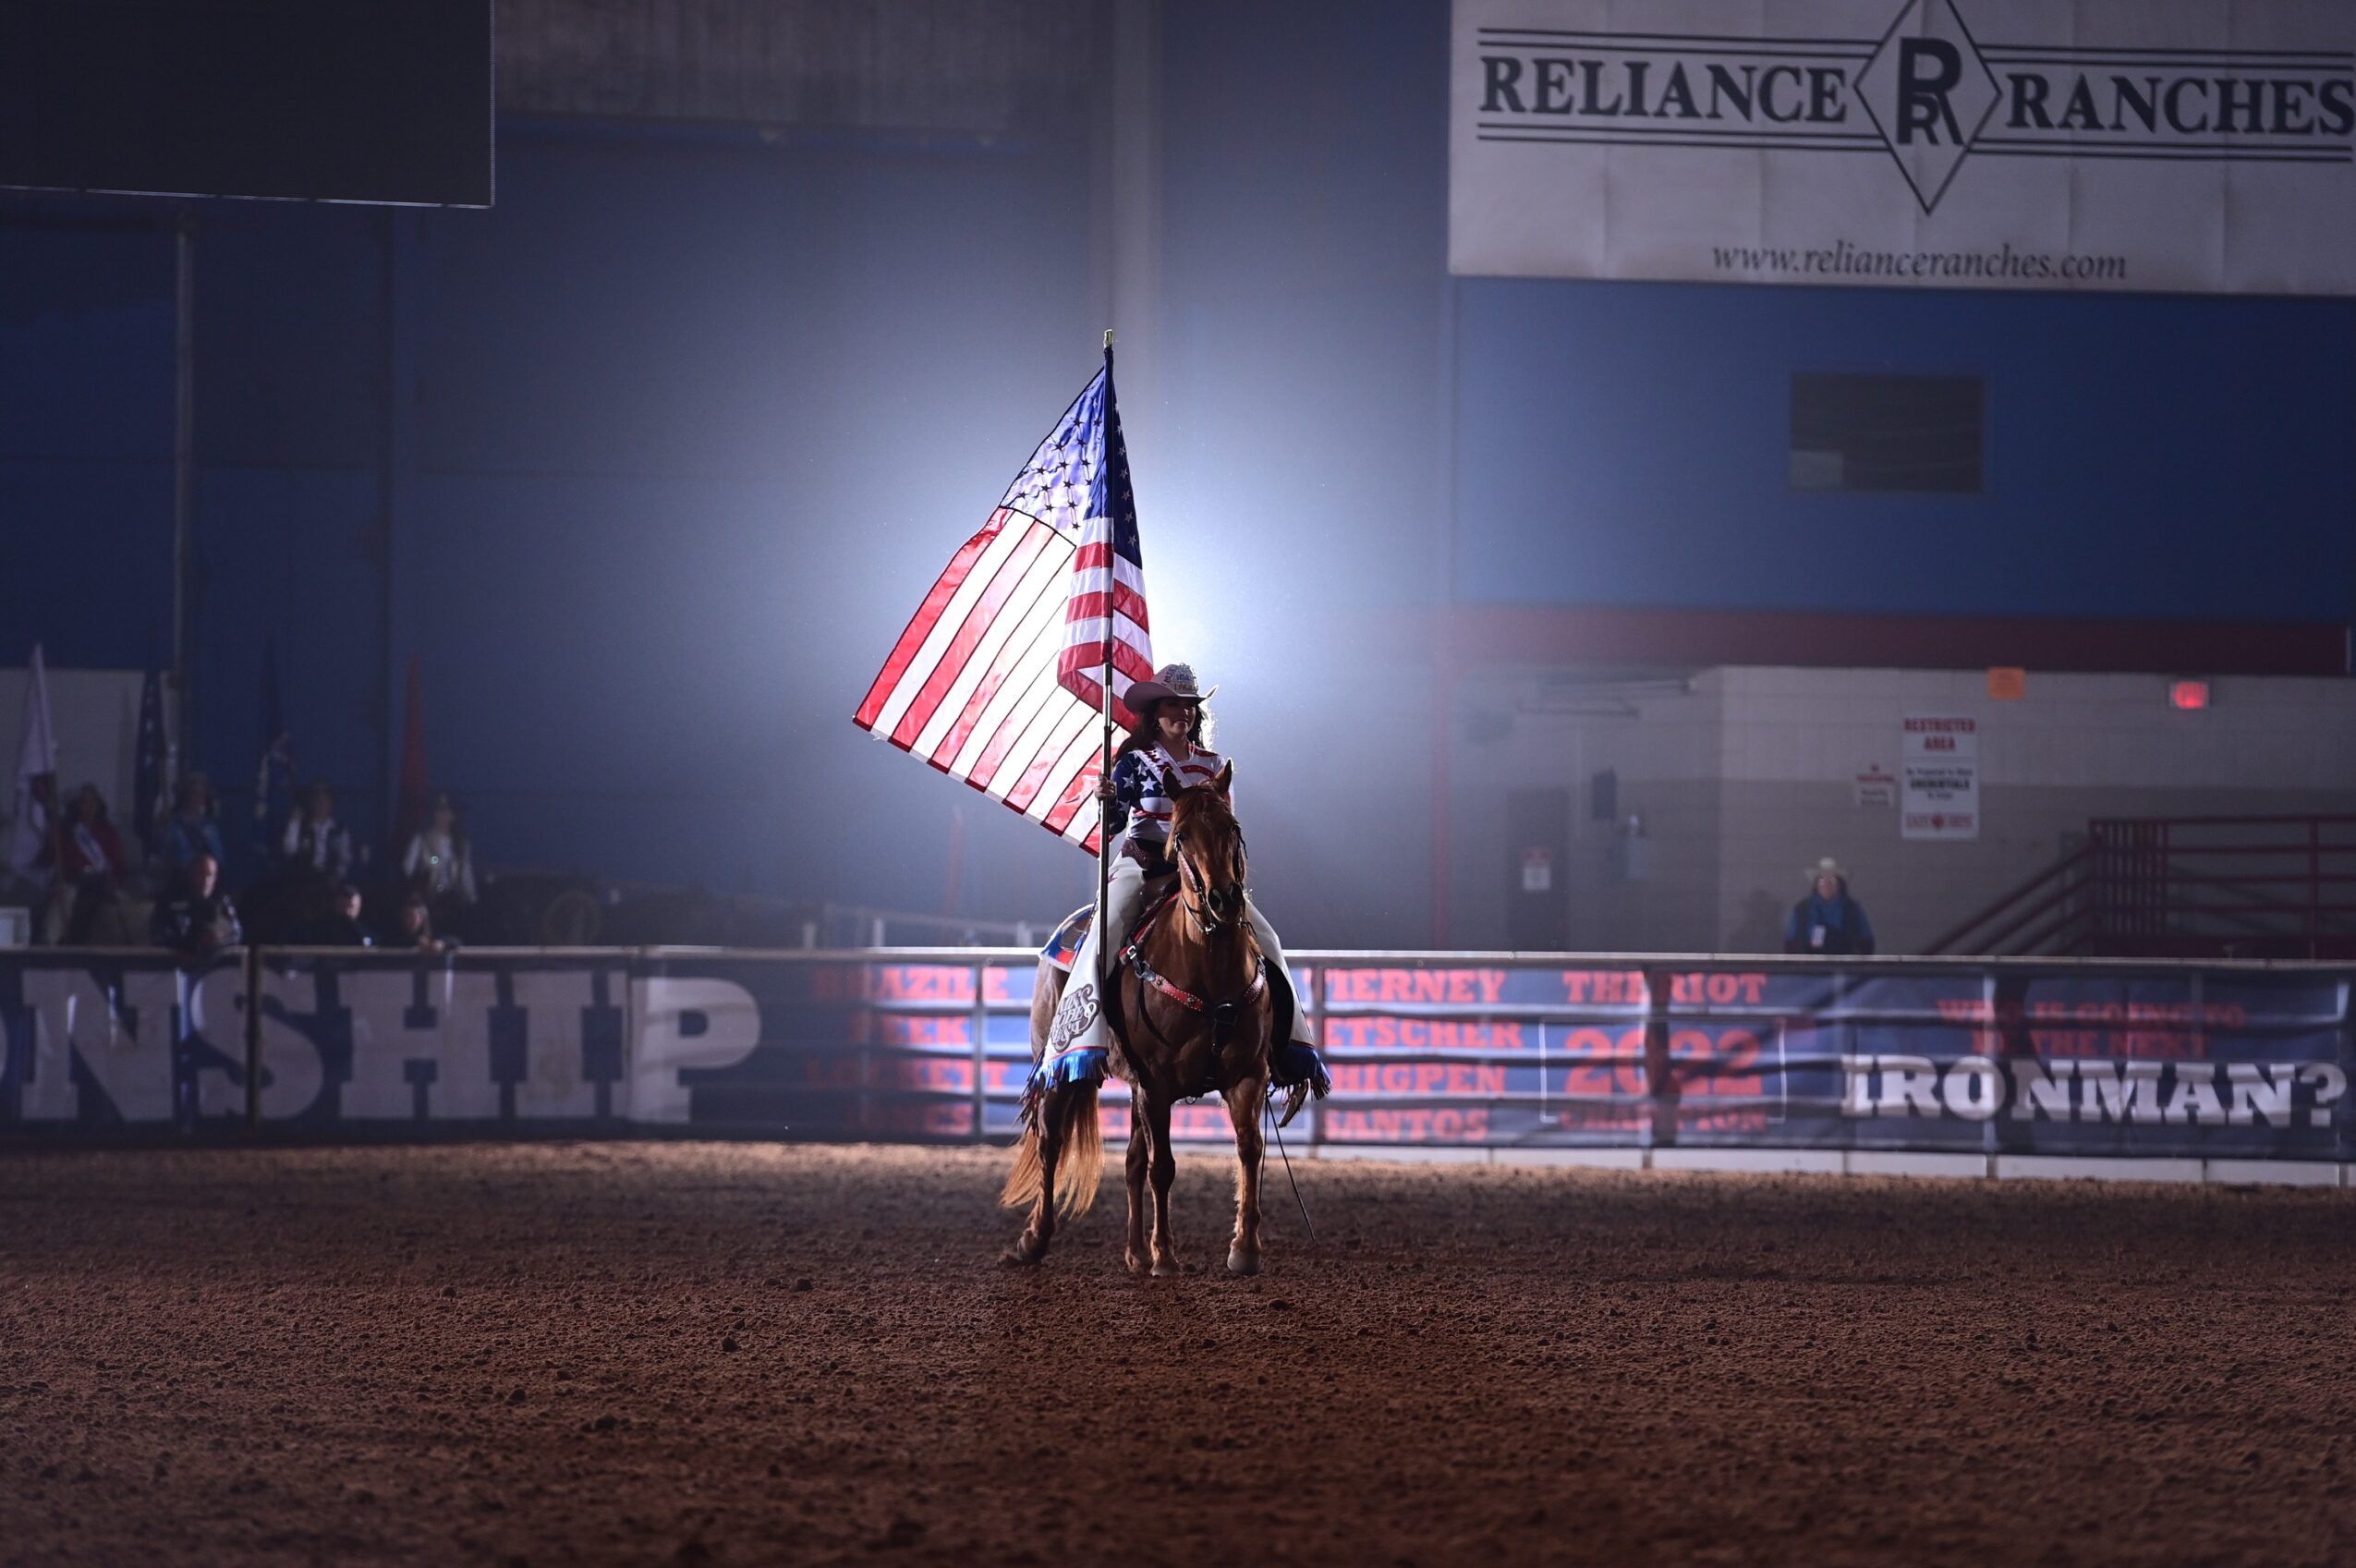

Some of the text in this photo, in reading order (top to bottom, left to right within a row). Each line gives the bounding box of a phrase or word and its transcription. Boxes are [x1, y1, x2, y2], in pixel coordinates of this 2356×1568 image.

[1478, 55, 1847, 124] RELIANCE
[2005, 72, 2355, 137] RANCHES
[1712, 240, 2127, 281] www.relianceranches.com
[1904, 718, 1976, 734] RESTRICTED
[1924, 736, 1957, 752] AREA
[0, 967, 761, 1122] NSHIP
[1305, 1015, 1524, 1050] ETSCHER
[1312, 1063, 1508, 1098] HIGPEN
[1564, 1026, 1764, 1097] 2022
[1840, 1054, 2348, 1128] IRONMAN?
